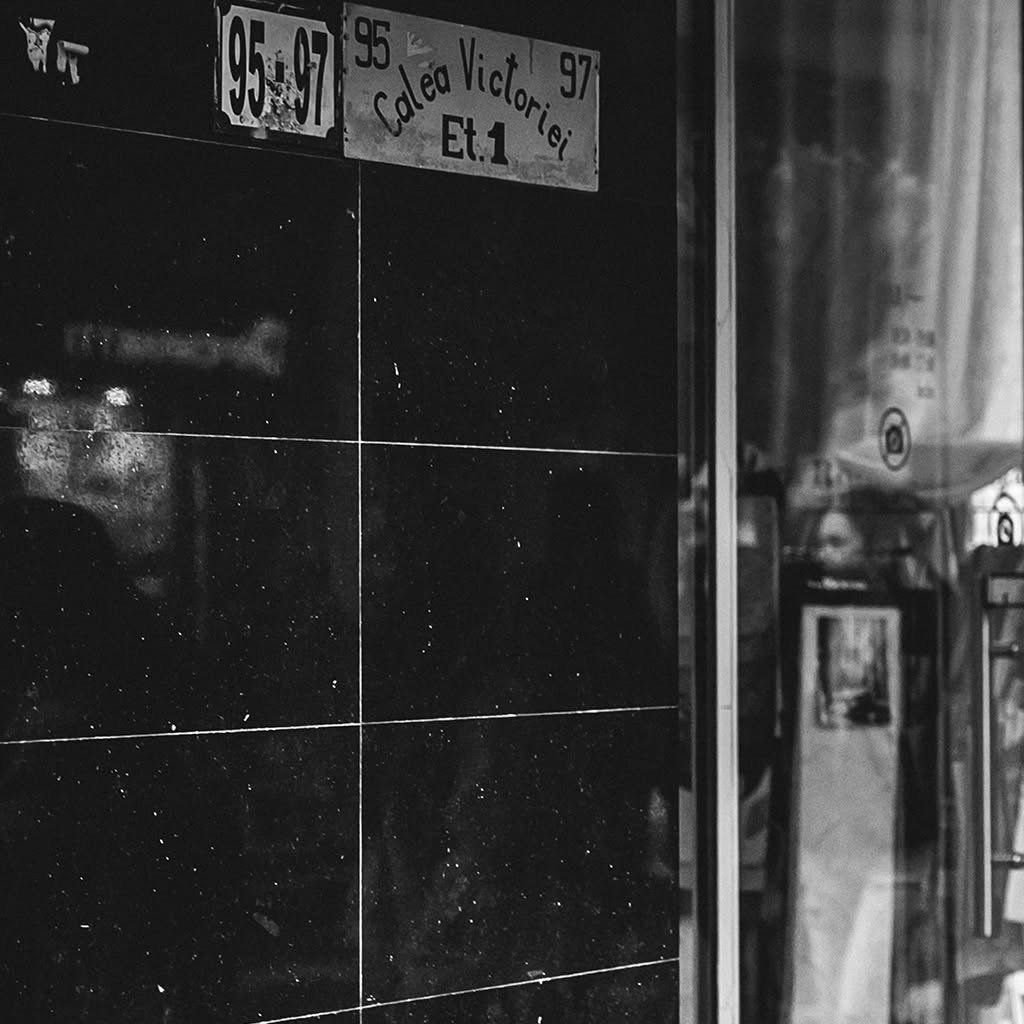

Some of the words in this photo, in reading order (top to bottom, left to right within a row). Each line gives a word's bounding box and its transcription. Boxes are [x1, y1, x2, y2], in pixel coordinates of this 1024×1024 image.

[354, 16, 391, 70] 95
[373, 63, 451, 138] Calea
[459, 37, 573, 161] Victoriei
[559, 51, 592, 100] 97
